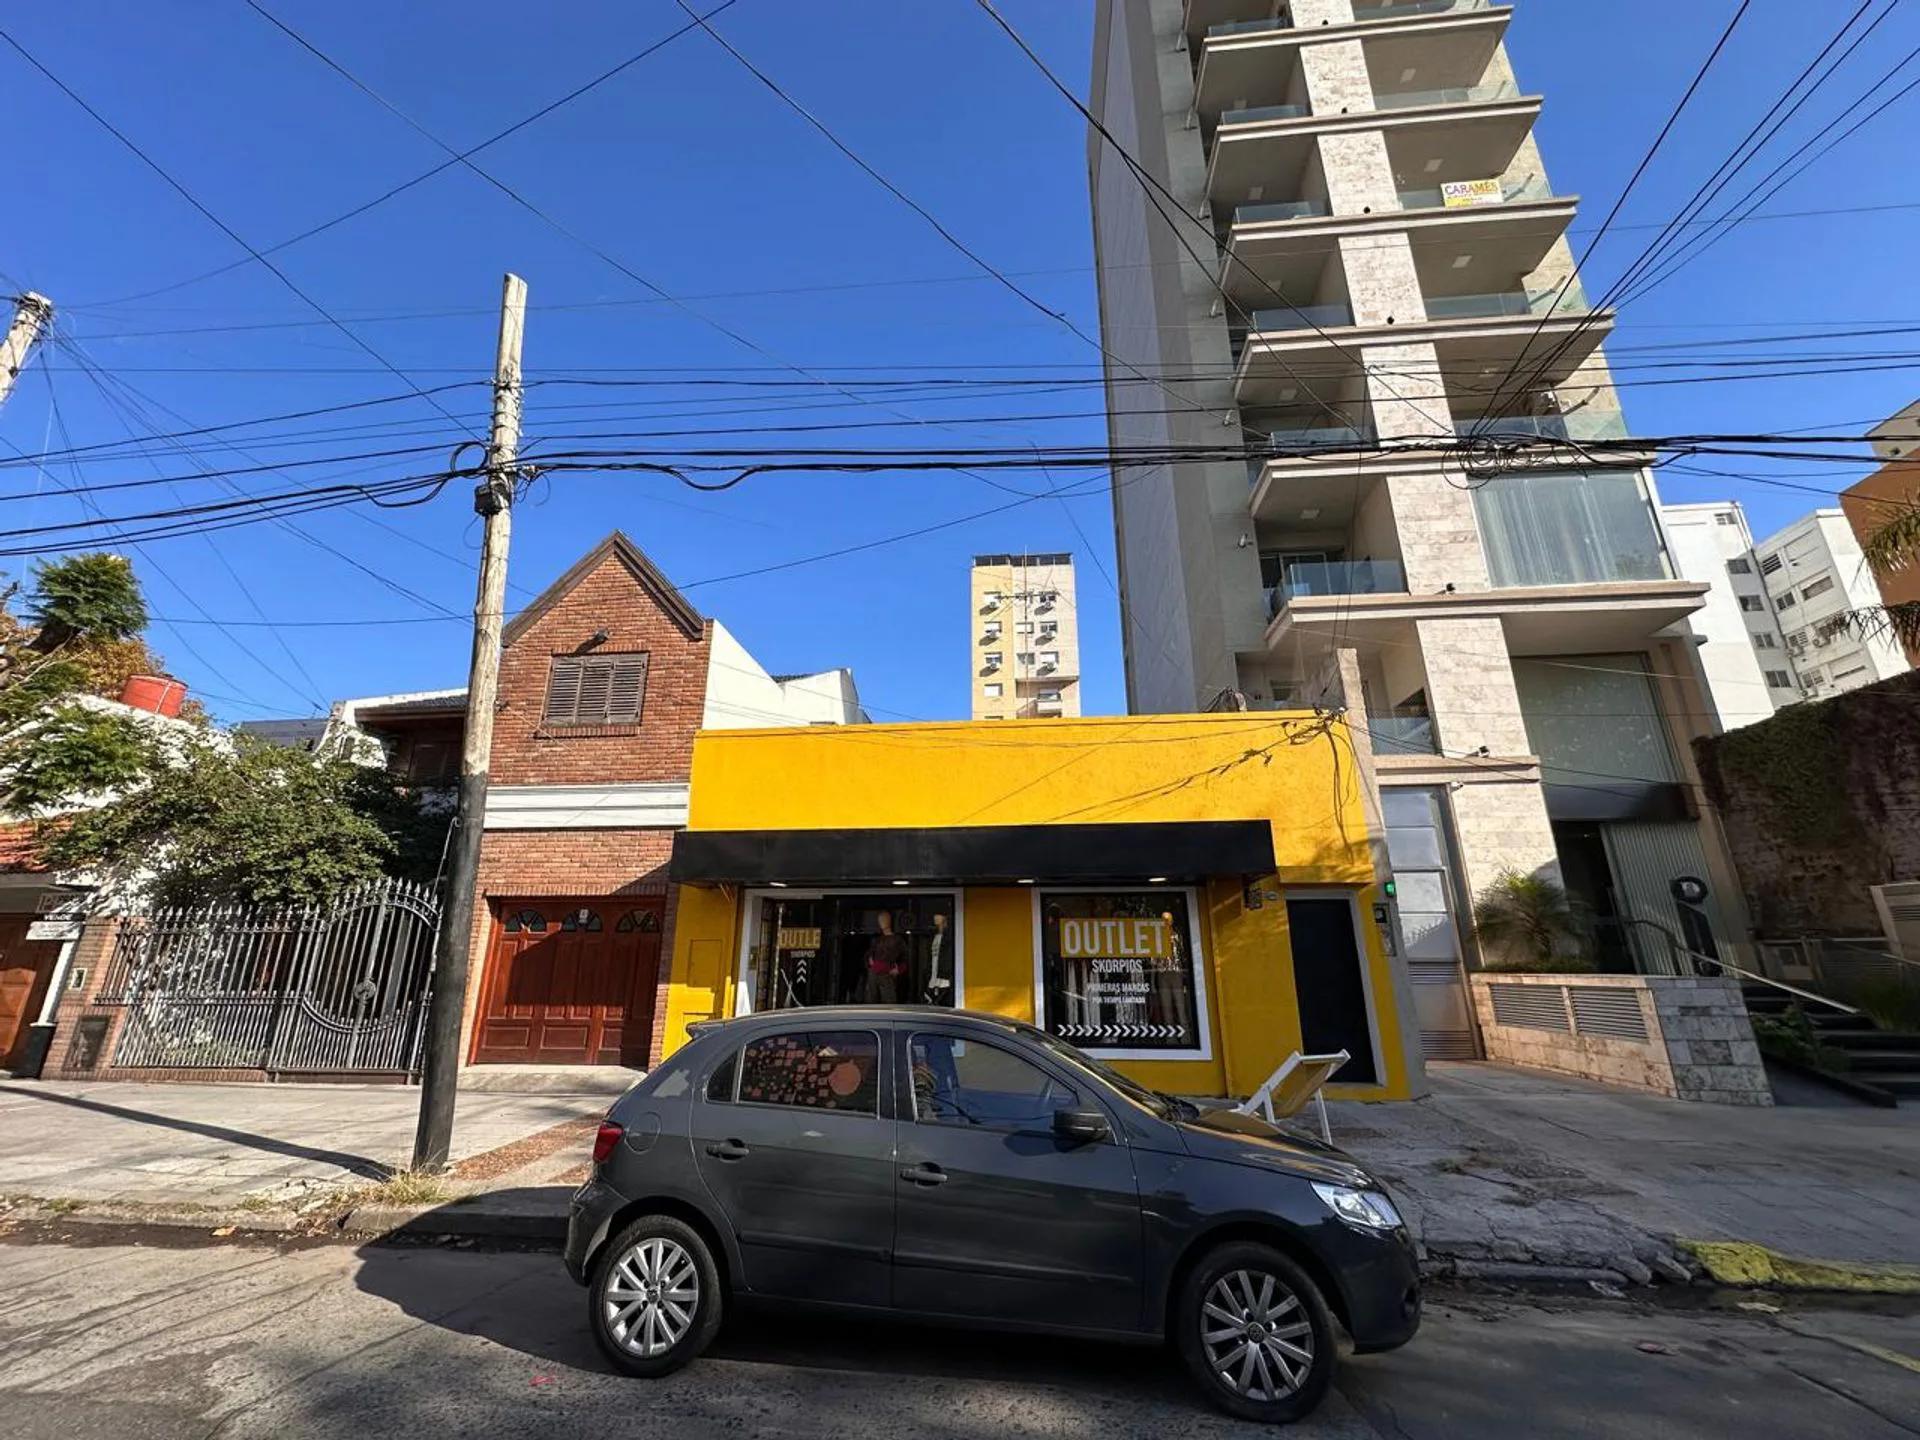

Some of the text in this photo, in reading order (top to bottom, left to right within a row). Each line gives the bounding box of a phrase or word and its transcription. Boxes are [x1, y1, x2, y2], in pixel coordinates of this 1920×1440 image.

[1064, 921, 1166, 954] OUTLET
[1092, 959, 1143, 973] SKORPIOS
[1122, 982, 1150, 993] MARCAS
